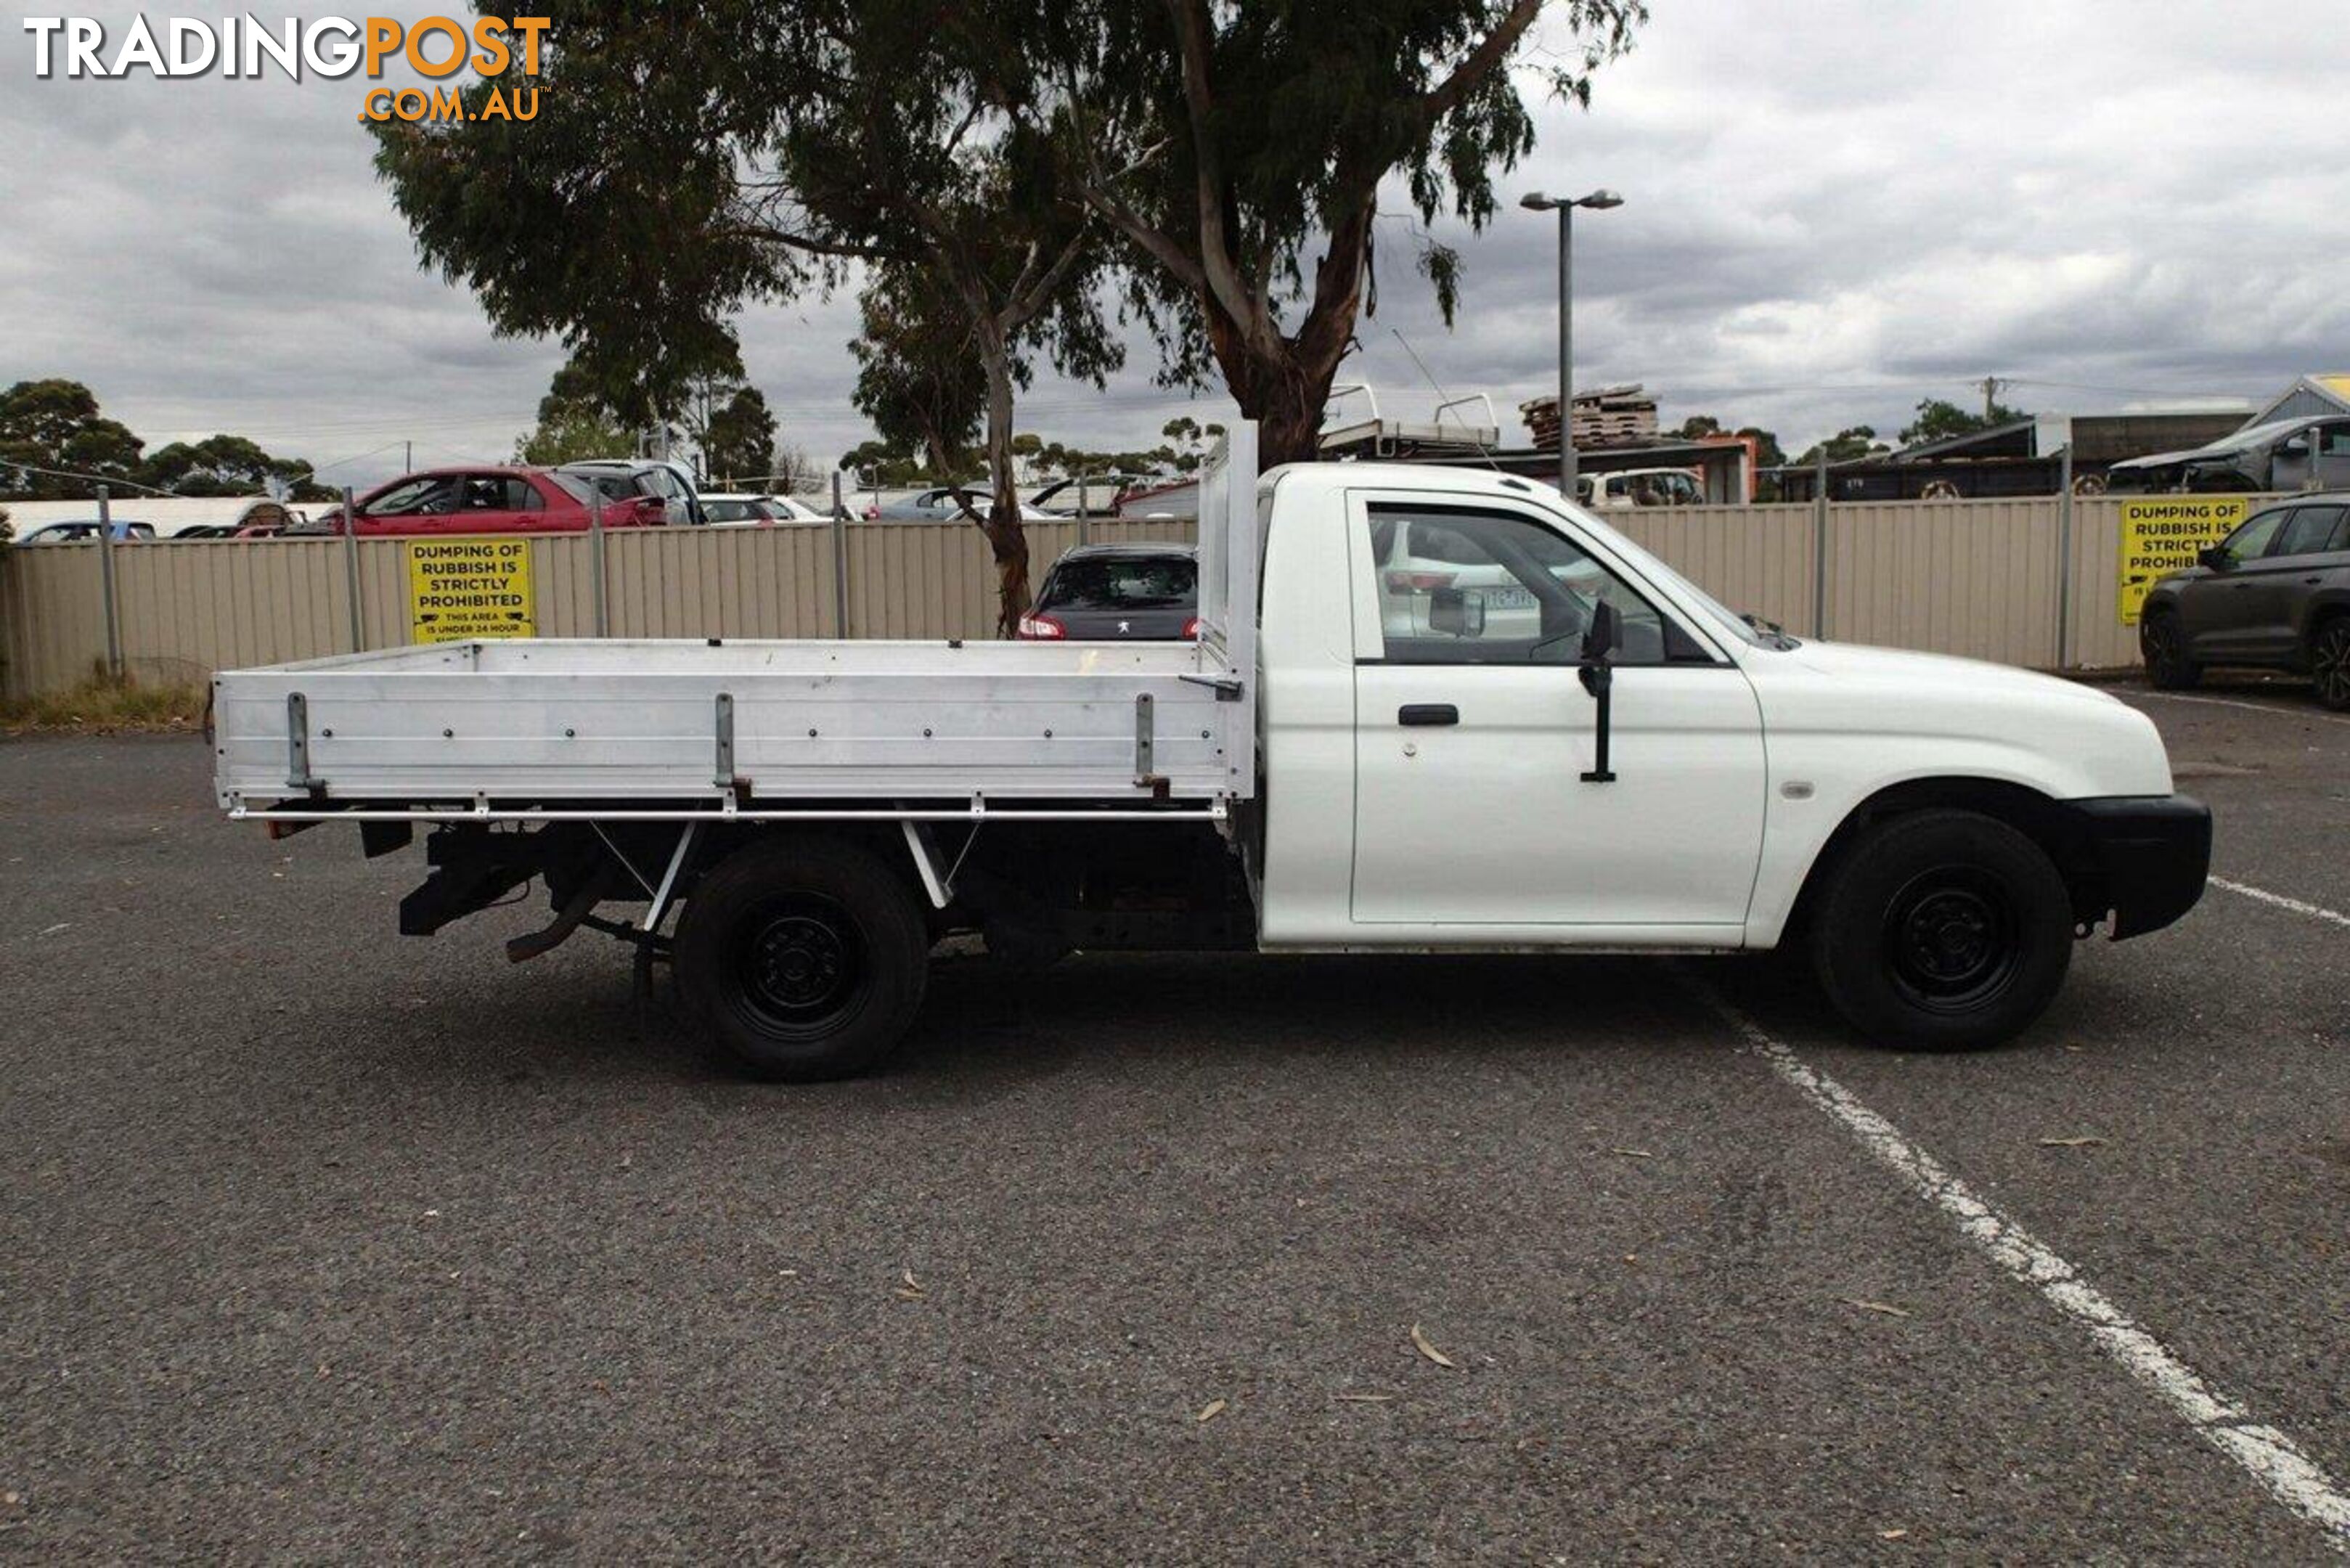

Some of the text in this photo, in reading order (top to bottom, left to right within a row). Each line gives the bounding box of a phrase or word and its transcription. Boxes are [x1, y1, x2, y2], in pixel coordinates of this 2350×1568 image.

[2130, 505, 2239, 519] DUMPING OF
[2137, 523, 2232, 535] RUBBISH IS
[415, 544, 522, 558] DUMPING OF
[423, 561, 517, 574] RUBBISH IS
[2130, 556, 2195, 568] PROHIB
[431, 579, 510, 592] STRICTLY
[420, 595, 523, 607] PROHIBITED
[438, 625, 473, 634] UNDER
